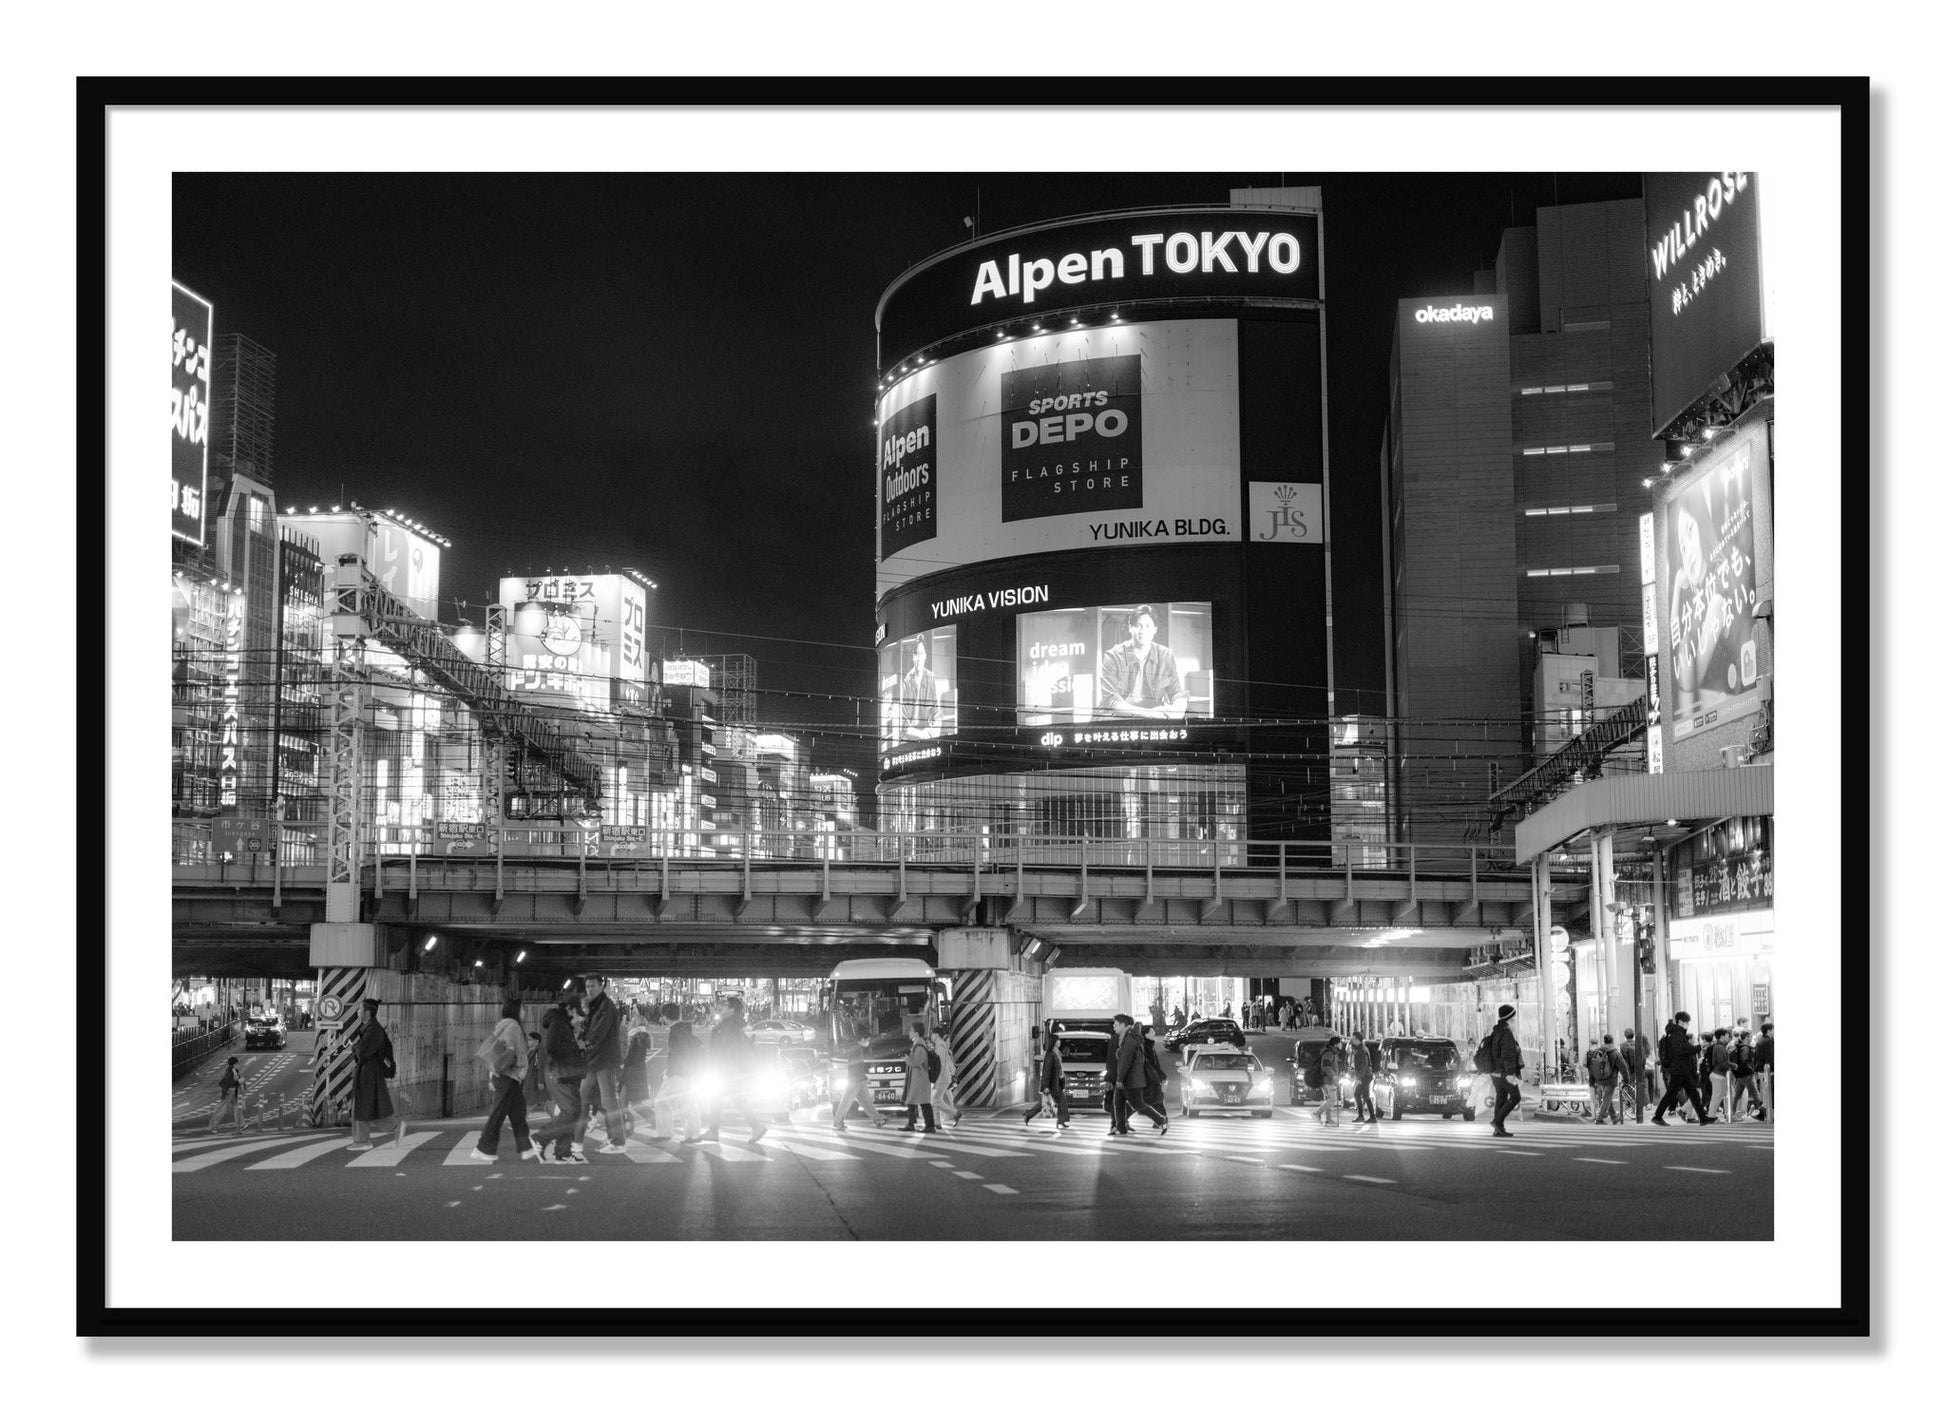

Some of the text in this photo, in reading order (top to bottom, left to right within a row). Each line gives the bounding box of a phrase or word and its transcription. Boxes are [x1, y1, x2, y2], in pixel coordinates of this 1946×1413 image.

[971, 231, 1301, 306] Alpen TOKYO
[1415, 303, 1493, 324] okadaya
[1028, 390, 1108, 416] SPORTS
[1011, 409, 1129, 449] DEPO
[883, 425, 930, 471] Alpen
[1011, 457, 1129, 482] FLAGSHIP
[886, 462, 929, 503] Outdoors
[1053, 475, 1129, 494] STORE
[883, 491, 930, 525] FLAGSHIP
[896, 508, 930, 532] STORE
[1090, 518, 1231, 541] YUNIKA BLDG.
[289, 585, 320, 606] SHISHA
[525, 579, 596, 599] プロミス
[1671, 545, 1751, 650] 自分本位でも、
[931, 584, 1049, 619] YUNIKA VISION
[1673, 584, 1756, 680] いいじゃない。
[1030, 642, 1085, 659] dream
[1041, 732, 1063, 747] dip
[1074, 730, 1188, 743] 夢を叶える仕事に出会おう
[438, 823, 484, 833] 新宿駅東口
[602, 826, 646, 836] 新宿駅東口
